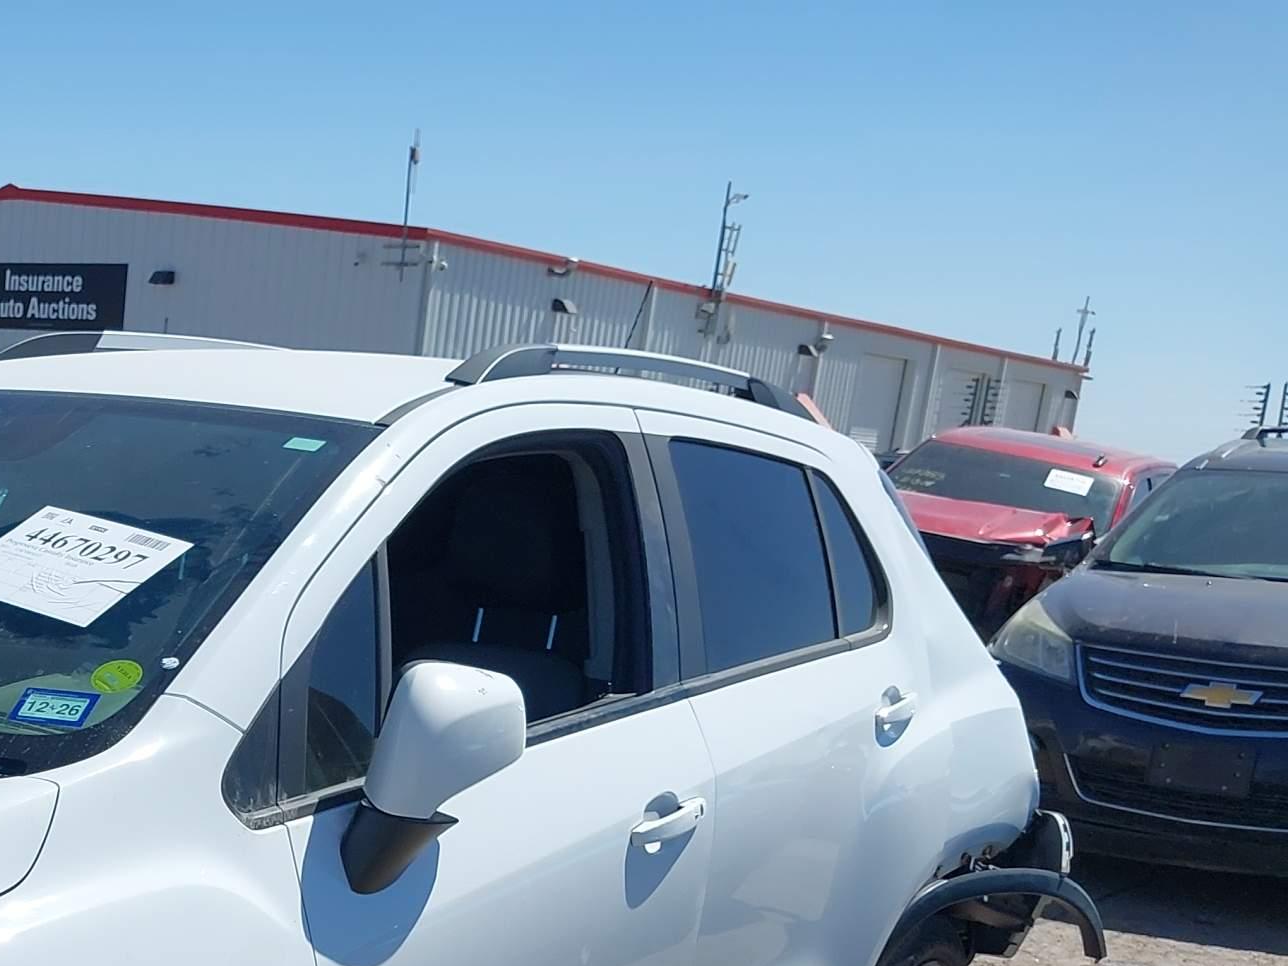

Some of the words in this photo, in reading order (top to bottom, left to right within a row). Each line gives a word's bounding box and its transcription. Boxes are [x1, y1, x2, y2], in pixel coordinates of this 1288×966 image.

[5, 268, 83, 292] Insurance
[27, 297, 97, 321] Auctions
[25, 527, 149, 569] 44670297
